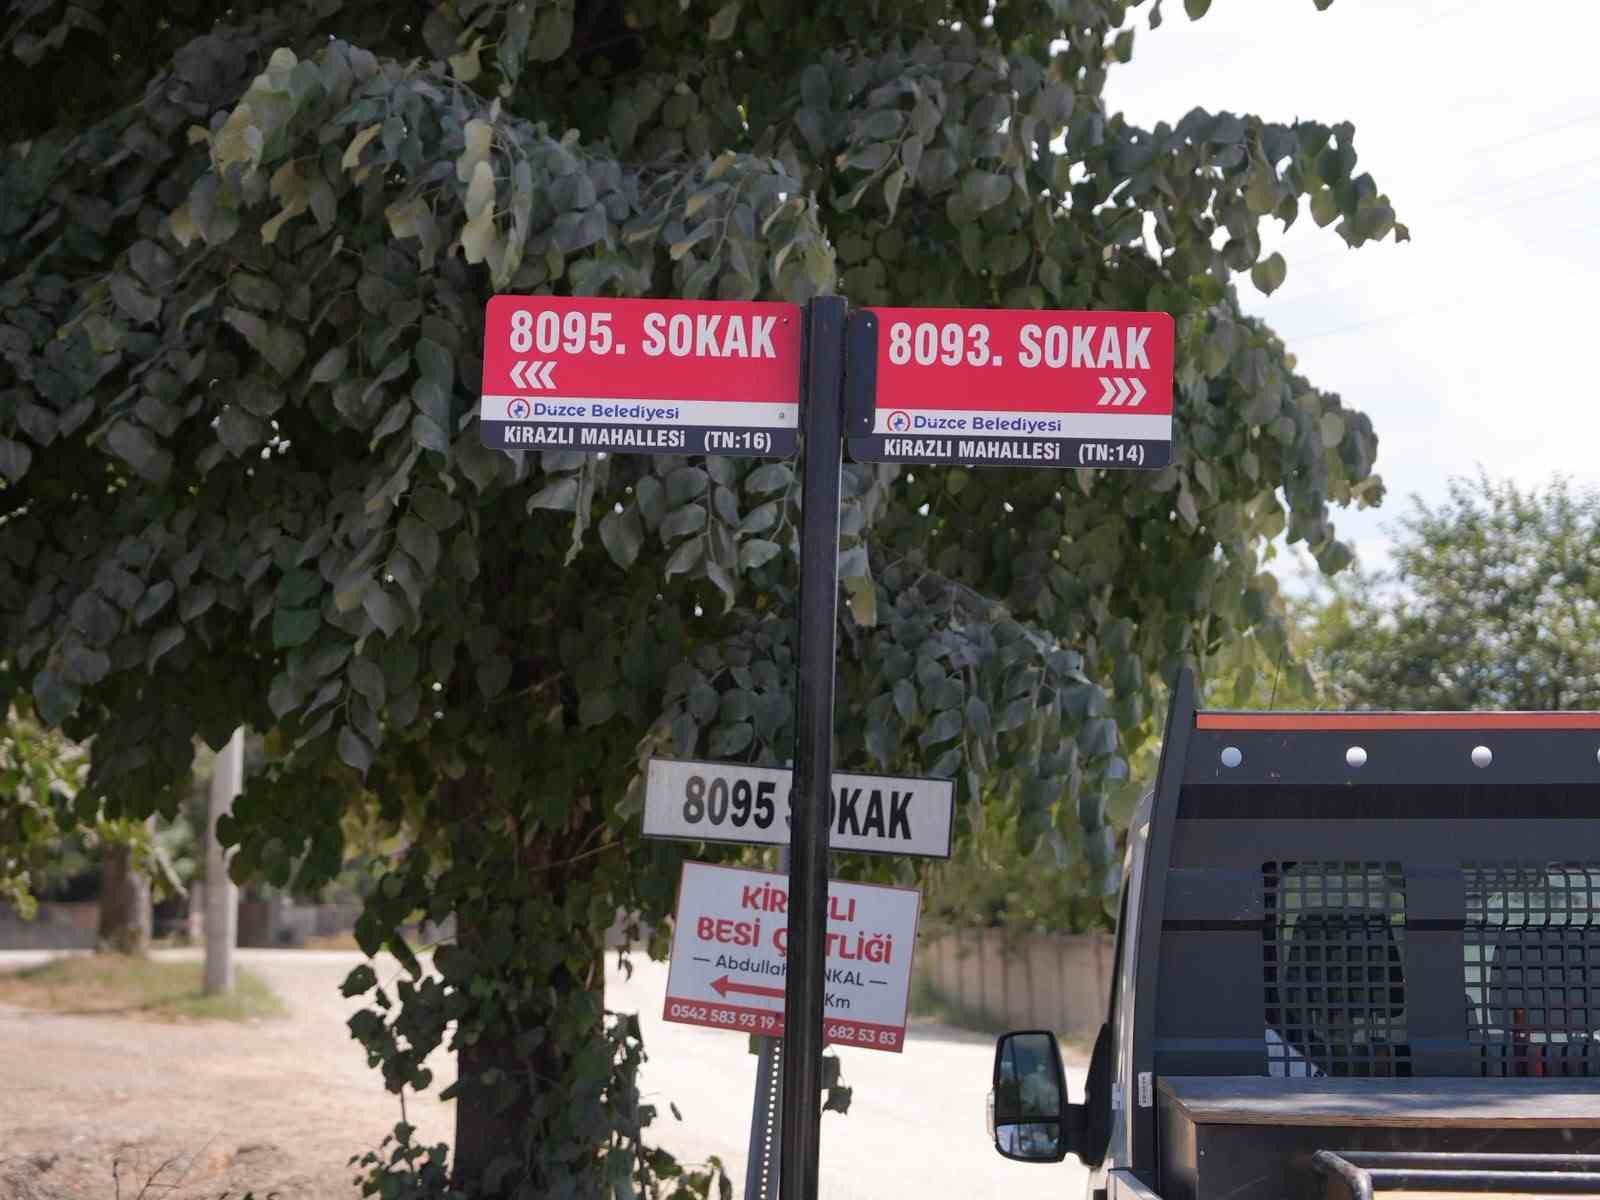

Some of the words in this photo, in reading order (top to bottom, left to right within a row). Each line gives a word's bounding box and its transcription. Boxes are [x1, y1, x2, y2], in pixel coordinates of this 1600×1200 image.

[510, 310, 625, 355] 8095.
[642, 312, 777, 359] SOKAK
[889, 322, 1002, 367] 8093.
[1018, 324, 1152, 370] SOKAK
[534, 403, 586, 417] Düzce
[592, 404, 679, 421] Belediyesi
[914, 416, 967, 430] Düzce
[972, 416, 1062, 434] Belediyesi
[704, 430, 772, 452] (TN:16)
[1078, 443, 1145, 466] (TN:14)
[683, 775, 776, 829] 8095
[785, 786, 915, 840] KAK
[741, 882, 856, 922] KİRLI
[697, 916, 761, 947] BESİ
[772, 926, 893, 964] ÇTLİĞİ
[671, 1003, 707, 1020] 0542
[710, 1010, 737, 1024] 583
[740, 1014, 756, 1028] 93
[760, 1016, 775, 1030] 19
[828, 1025, 856, 1040] 682
[858, 1029, 876, 1042] 53
[879, 1032, 897, 1045] 83
